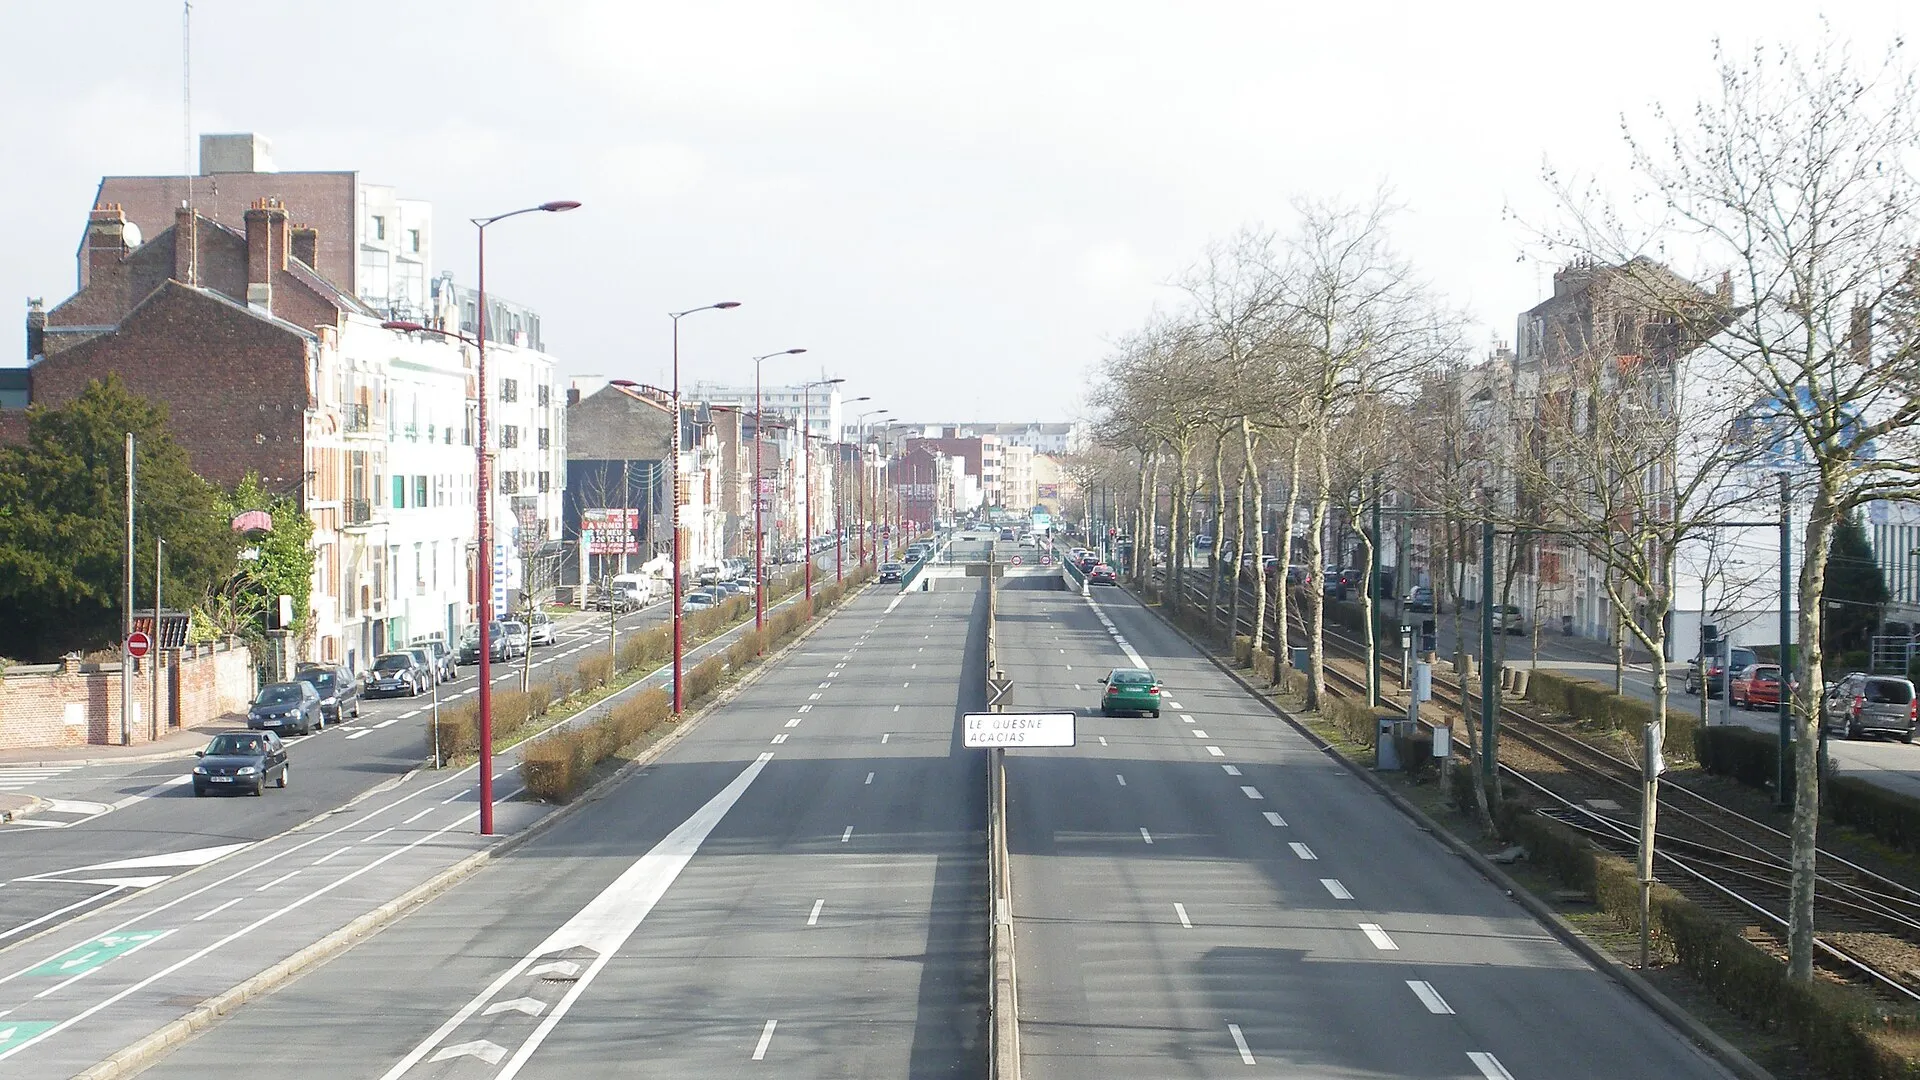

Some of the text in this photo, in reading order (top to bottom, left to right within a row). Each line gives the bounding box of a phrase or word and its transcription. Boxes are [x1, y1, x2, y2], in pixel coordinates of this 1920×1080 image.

[969, 719, 1043, 729] LE QUESNE
[970, 733, 1025, 742] ACACIAS
